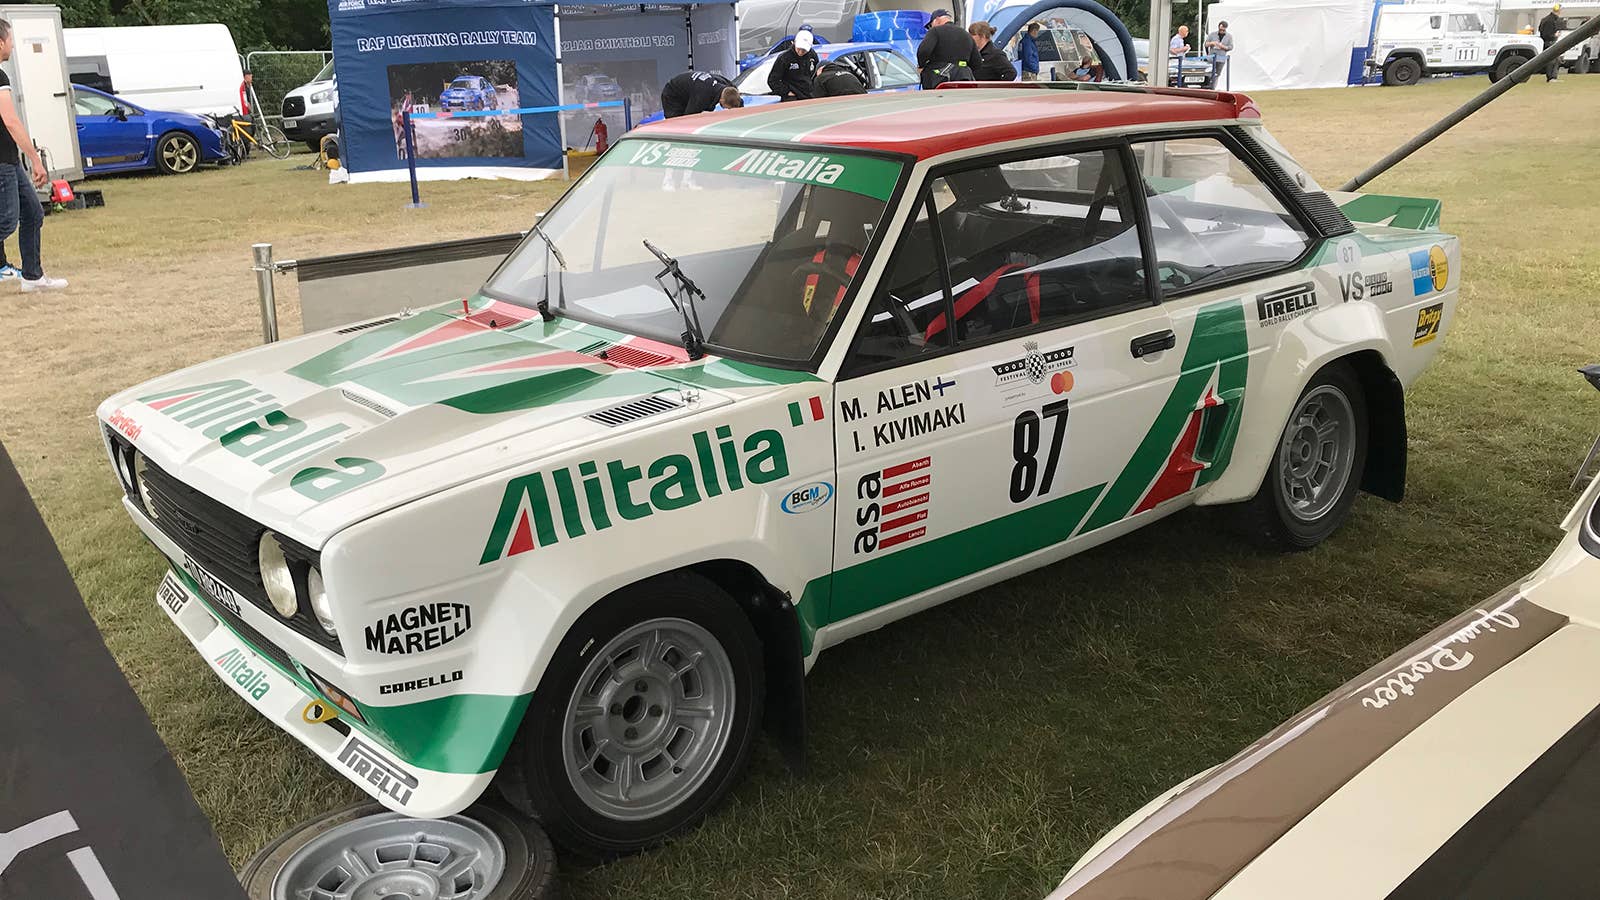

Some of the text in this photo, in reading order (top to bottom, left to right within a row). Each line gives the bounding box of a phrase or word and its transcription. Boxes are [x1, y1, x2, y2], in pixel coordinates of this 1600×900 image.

[357, 30, 536, 51] RAF LIGHTNING RALLY TEAM
[1457, 48, 1475, 60] 111
[628, 142, 672, 165] VS
[722, 149, 845, 184] Alitalia
[1343, 246, 1353, 263] 87
[1256, 281, 1318, 321] PIRELLI
[1338, 271, 1364, 303] VS
[1419, 307, 1442, 332] Britax
[997, 350, 1072, 373] GOOD WOOD
[1000, 372, 1026, 382] FESTIVAL
[1056, 359, 1072, 368] SPEED
[840, 380, 931, 423] M. ALEN
[136, 379, 386, 502] Alitalia
[853, 403, 966, 453] I. KIVIMAKI
[912, 459, 930, 469] Abarth
[1009, 399, 1069, 504] 87
[478, 425, 790, 566] Alitalia
[791, 486, 820, 505] BGM
[899, 477, 929, 491] Alfa Romeo
[854, 471, 881, 554] asa
[896, 494, 929, 509] Autobianchi
[916, 512, 927, 520] Fiat
[908, 529, 925, 539] Lancia
[158, 574, 189, 615] PIRELLI
[365, 602, 472, 640] MAGNETI
[365, 617, 472, 654] MARELLI
[1362, 608, 1520, 709] Jim Porter
[214, 648, 270, 702] Alitalia
[379, 670, 463, 695] CARELLO
[337, 736, 419, 806] PIRELLI
